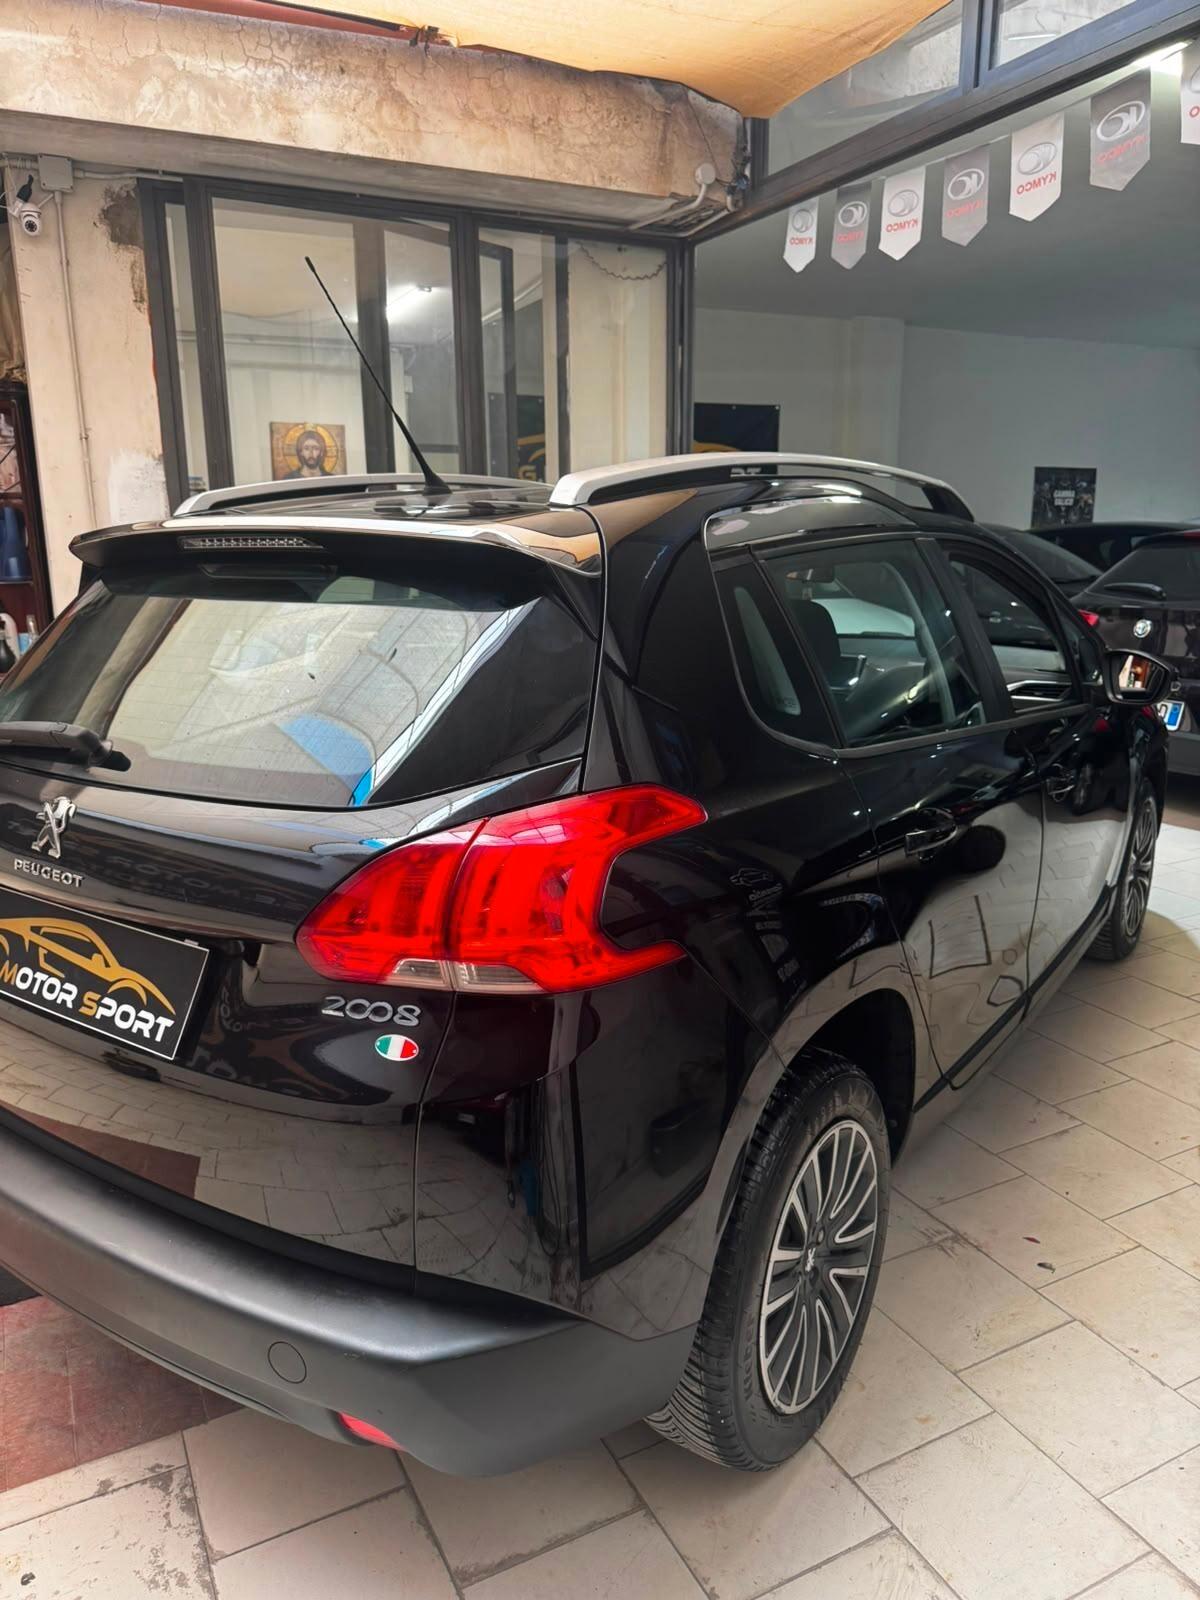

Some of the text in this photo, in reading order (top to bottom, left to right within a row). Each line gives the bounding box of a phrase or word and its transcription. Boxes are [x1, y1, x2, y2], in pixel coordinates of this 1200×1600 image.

[14, 858, 83, 887] PEUGEOT
[0, 960, 78, 1009] MOTOR
[79, 991, 175, 1042] SPORT
[321, 995, 421, 1026] 2008
